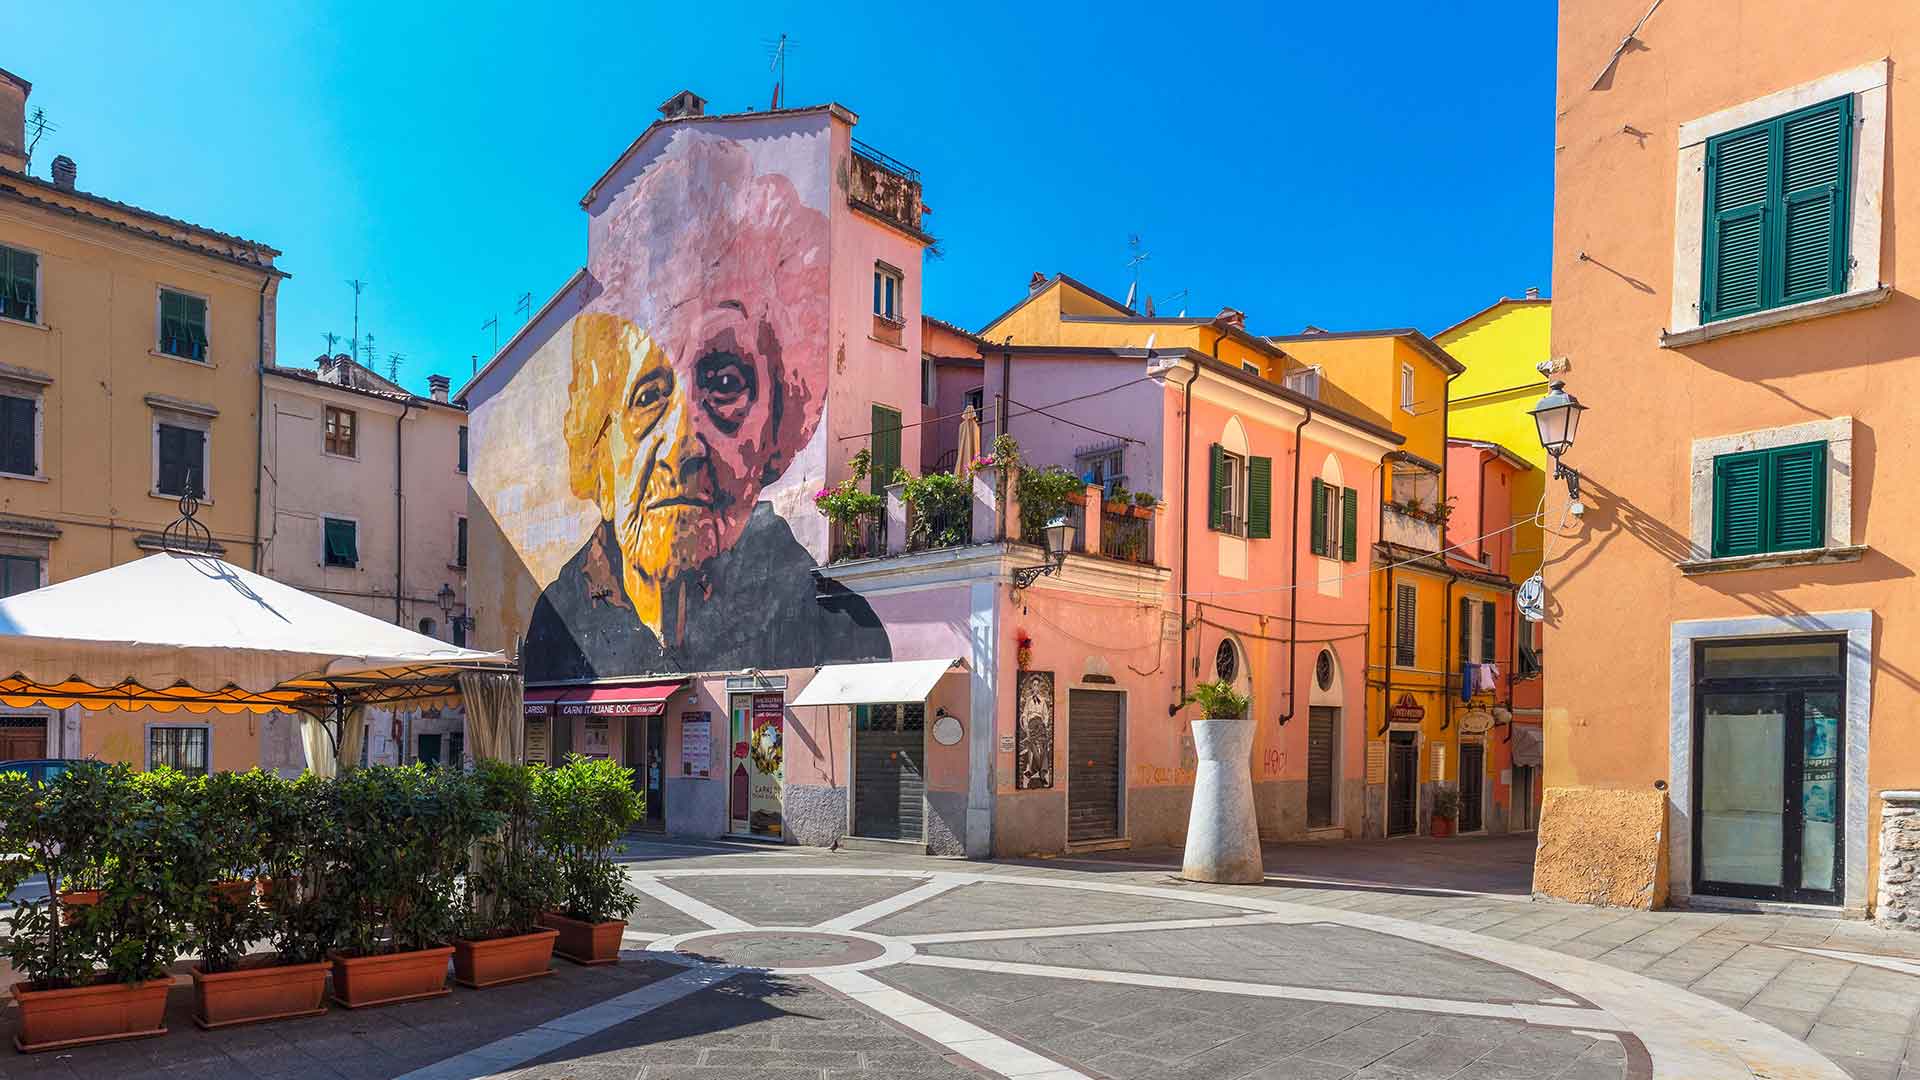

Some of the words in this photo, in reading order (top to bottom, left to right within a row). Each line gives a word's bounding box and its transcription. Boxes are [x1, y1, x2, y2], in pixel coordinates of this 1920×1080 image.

[525, 704, 548, 714] LARISSA
[563, 705, 583, 714] CARNI
[584, 704, 615, 714] ITALIANE
[616, 704, 631, 713] DOC
